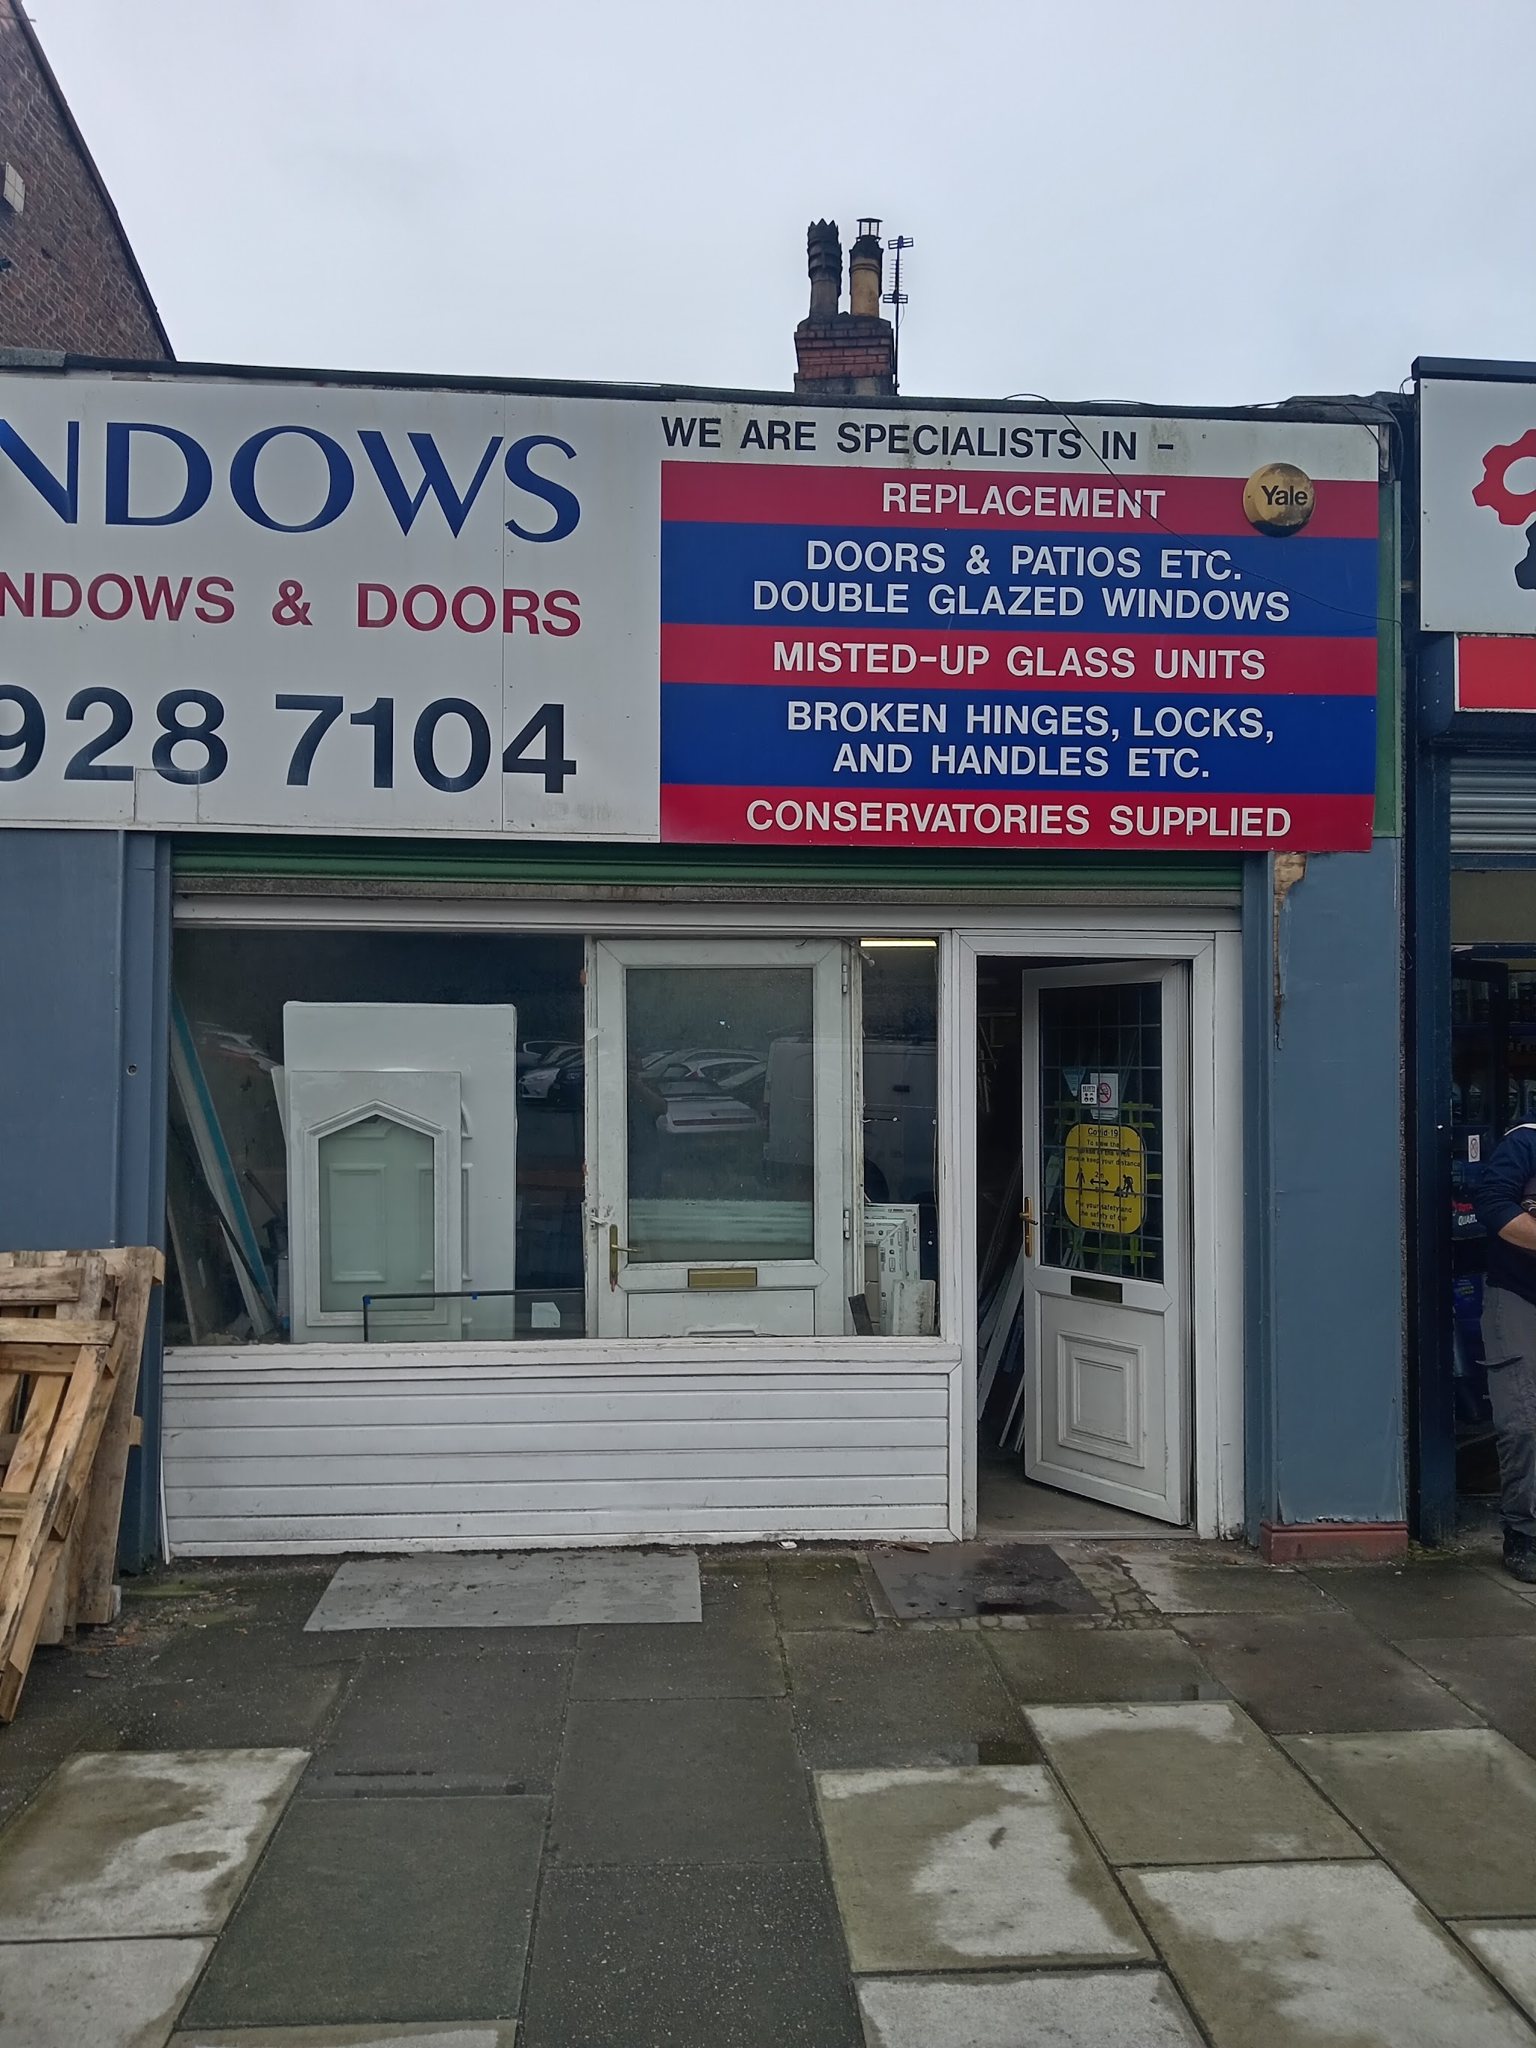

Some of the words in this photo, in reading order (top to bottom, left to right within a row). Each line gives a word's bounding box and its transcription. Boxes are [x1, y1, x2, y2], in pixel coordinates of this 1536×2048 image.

[661, 416, 721, 448] WE
[740, 420, 817, 451] ARE
[836, 423, 1082, 461] SPECIALISTS
[1101, 430, 1137, 461] IN
[0, 419, 581, 543] NDOWS
[883, 482, 1166, 519] REPLACEMENT
[1261, 485, 1308, 506] Yale
[807, 540, 946, 574] DOORS
[965, 544, 991, 575] &
[1012, 545, 1141, 579] PATIOS
[1161, 549, 1242, 581] ETC.
[0, 572, 235, 624] NDOWS
[272, 579, 313, 627] &
[357, 583, 581, 637] DOORS
[754, 580, 909, 614] DOUBLE
[928, 584, 1084, 617] GLAZED
[1101, 587, 1291, 622] WINDOWS
[773, 641, 990, 676] MISTED-UP
[1006, 645, 1135, 680] GLASS
[1155, 649, 1266, 680] UNITS
[0, 684, 229, 786] 928
[275, 694, 577, 793] 7104
[787, 701, 947, 734] BROKEN
[967, 704, 1119, 742] HINGES,
[1134, 706, 1275, 743] LOCKS,
[832, 743, 912, 774] AND
[932, 744, 1109, 777] HANDLES
[1128, 748, 1210, 778] ETC.
[746, 799, 1090, 836] CONSERVATORIES
[1109, 805, 1291, 838] SUPPLIED
